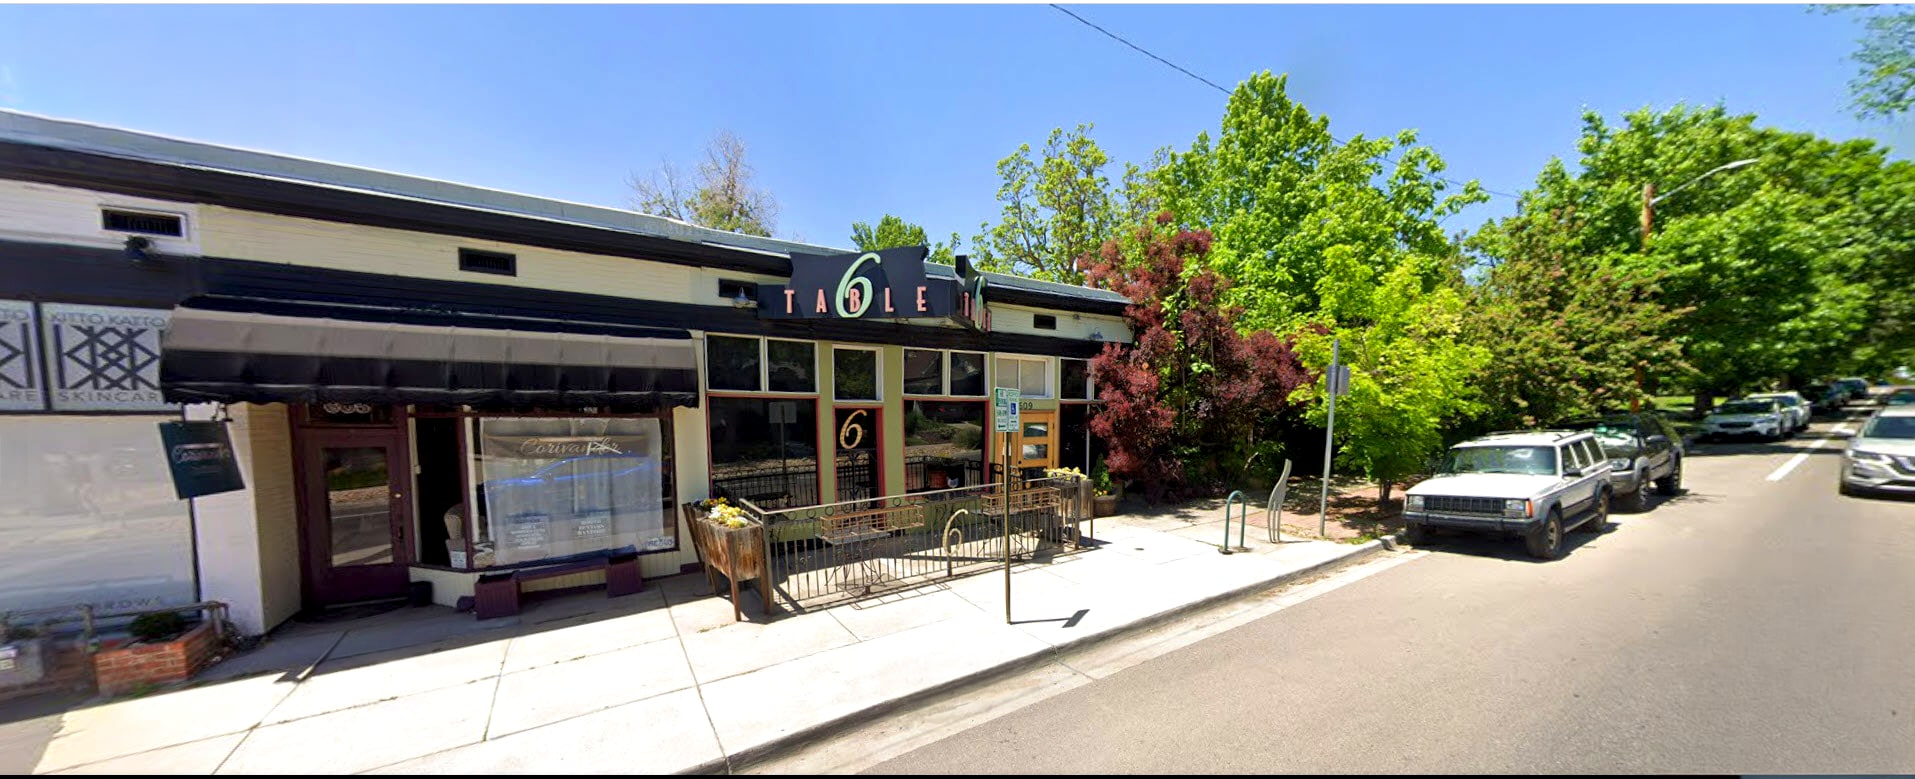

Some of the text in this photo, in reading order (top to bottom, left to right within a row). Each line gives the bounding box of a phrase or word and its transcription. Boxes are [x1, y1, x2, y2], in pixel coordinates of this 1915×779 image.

[784, 286, 928, 314] TABLE
[835, 252, 881, 318] 6
[108, 314, 166, 327] KATTO
[58, 390, 160, 403] SKINCAR
[839, 409, 867, 450] 6
[942, 508, 969, 556] 6
